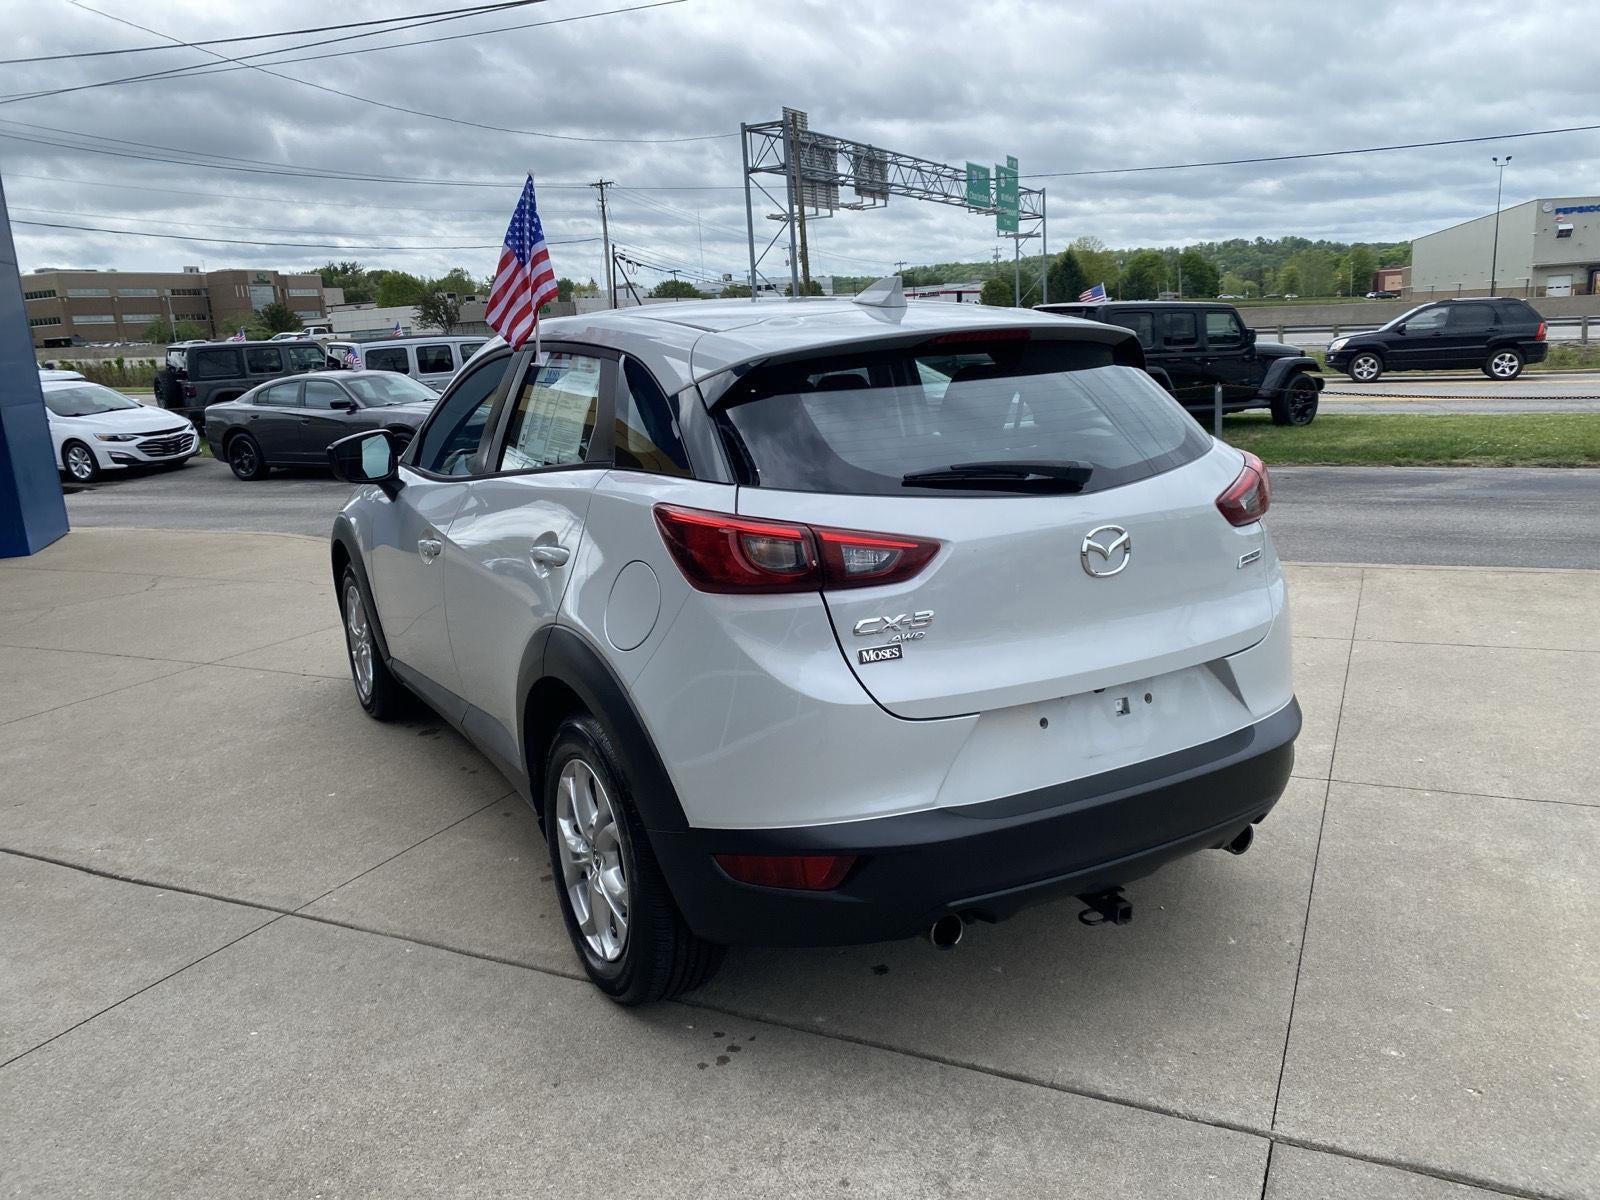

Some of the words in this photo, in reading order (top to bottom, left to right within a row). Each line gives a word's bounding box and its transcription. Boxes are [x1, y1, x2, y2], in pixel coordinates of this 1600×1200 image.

[853, 610, 934, 636] CX-3
[888, 631, 926, 643] AWD
[861, 647, 900, 662] MOSES
